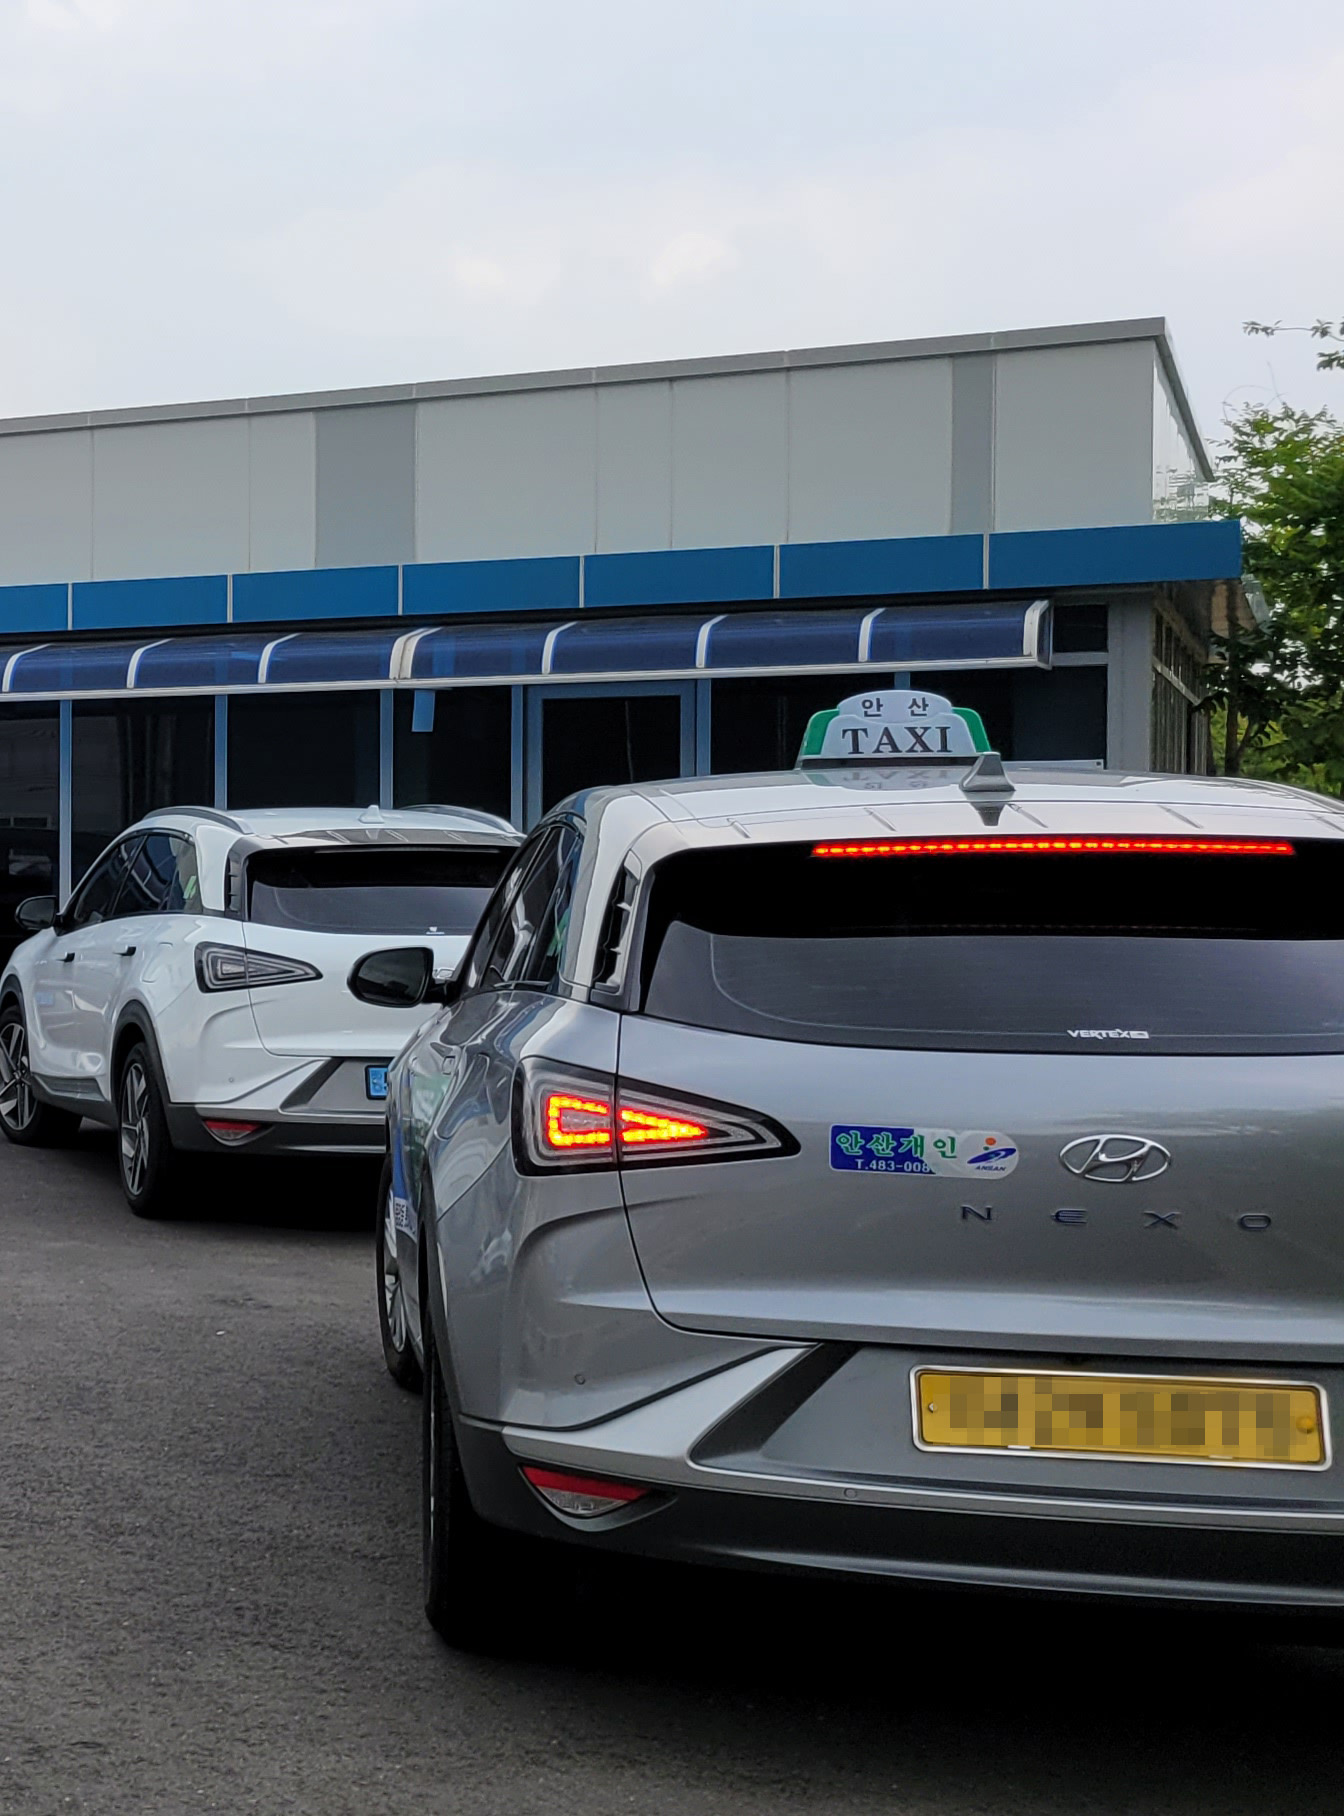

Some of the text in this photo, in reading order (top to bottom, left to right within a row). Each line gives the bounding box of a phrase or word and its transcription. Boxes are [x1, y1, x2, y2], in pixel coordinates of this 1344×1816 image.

[841, 726, 953, 755] TAXI
[835, 1130, 958, 1160] 안산개인
[960, 1205, 1274, 1231] NEXO
